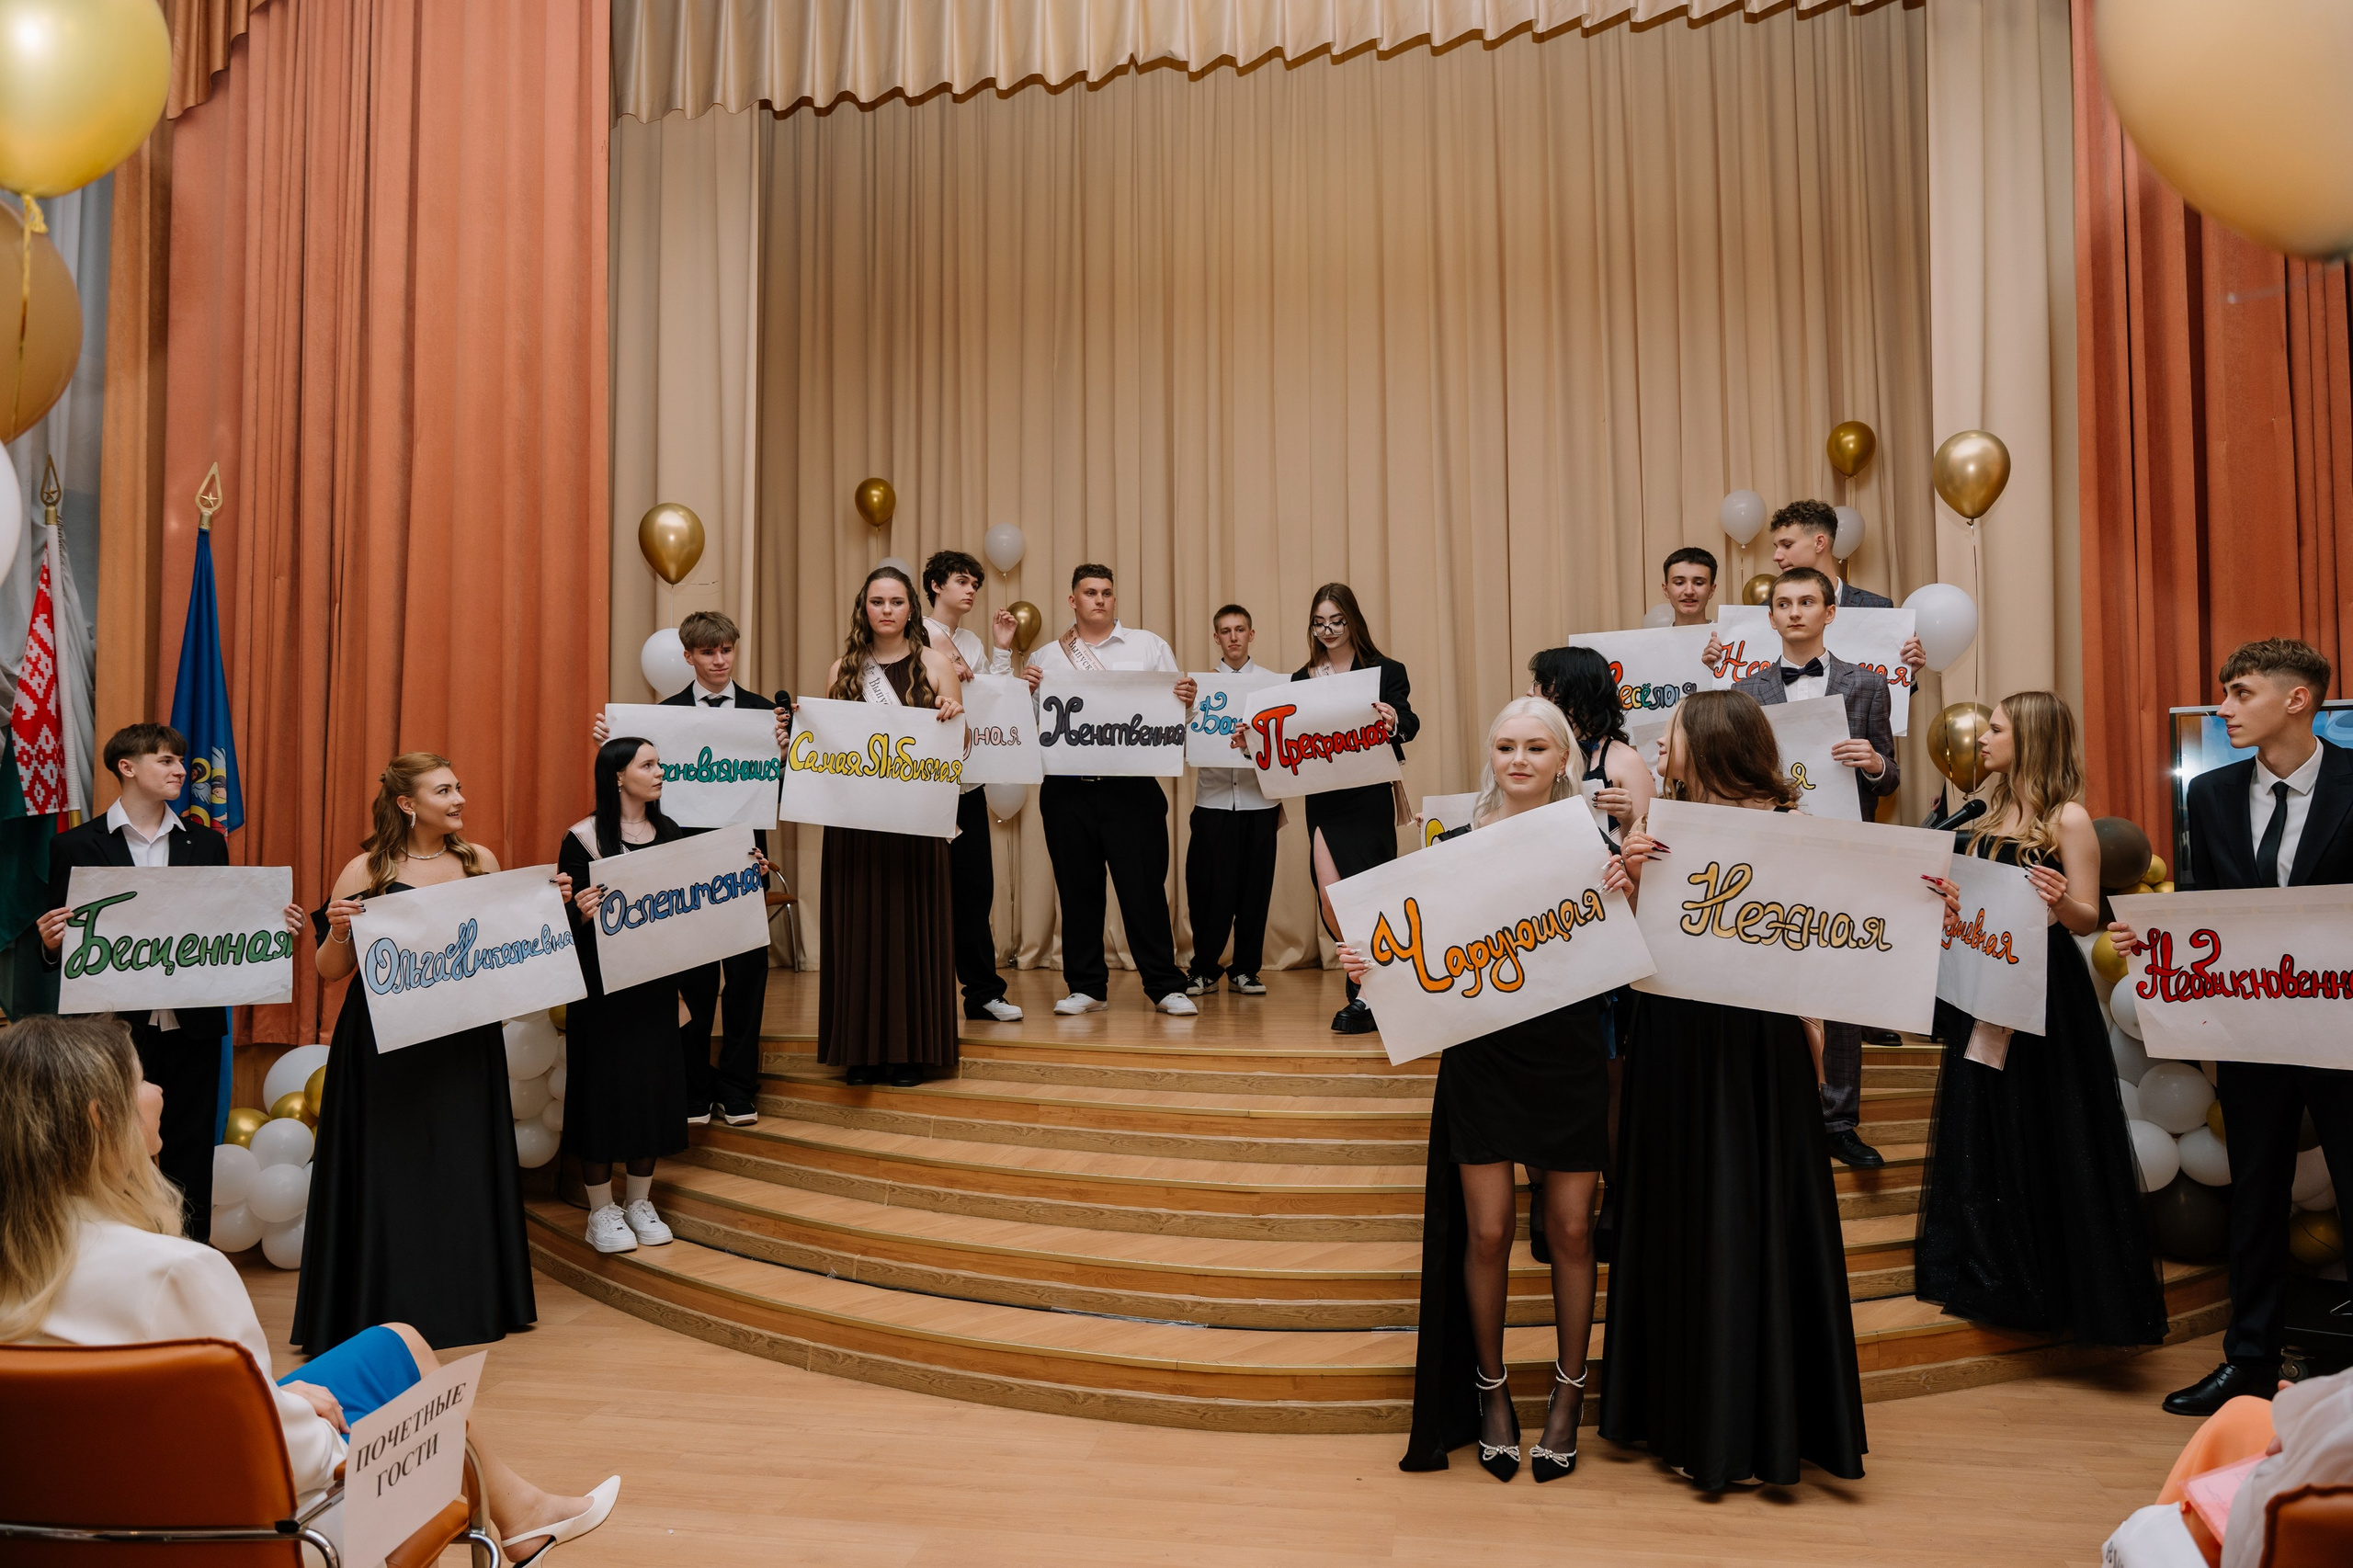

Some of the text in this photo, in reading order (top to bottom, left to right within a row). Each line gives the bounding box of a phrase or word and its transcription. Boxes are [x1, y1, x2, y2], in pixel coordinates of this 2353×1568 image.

[789, 731, 963, 785] Самая Любимая
[1039, 696, 1186, 747] Женственная
[1251, 704, 1391, 776] Прекрасная
[64, 891, 292, 980] Бесценная
[1370, 888, 1606, 998] Чарующая
[1680, 861, 1893, 951] Нежная
[1940, 907, 2019, 965] ушевная
[365, 918, 574, 994] Ольга Николаевна
[2131, 927, 2353, 1003] Необыкновенн
[356, 1382, 467, 1474] ПОЧЕТНЫЕ
[376, 1431, 439, 1498] ГОСТИ
